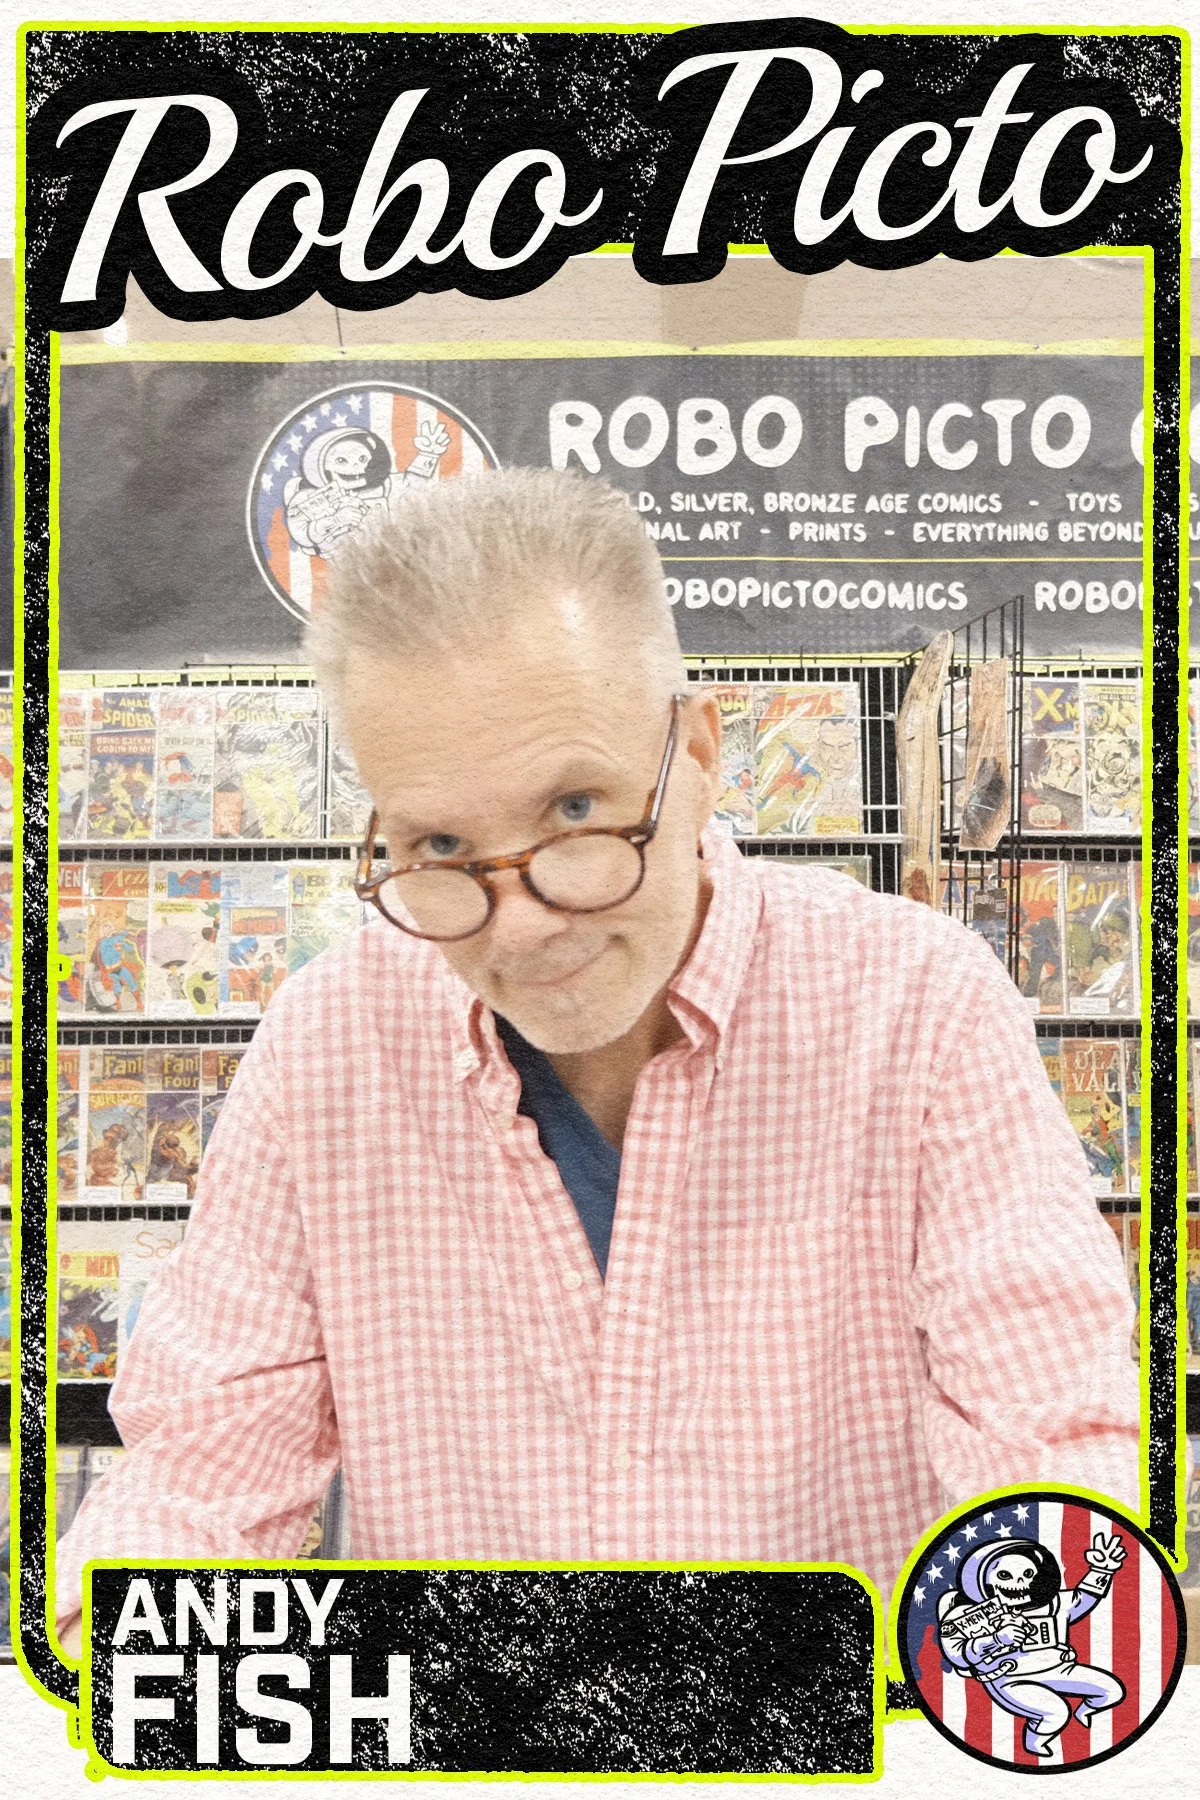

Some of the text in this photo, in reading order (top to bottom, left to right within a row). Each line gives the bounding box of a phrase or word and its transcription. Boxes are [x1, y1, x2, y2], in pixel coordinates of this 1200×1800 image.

[549, 395, 802, 475] ROBO
[844, 395, 1091, 472] PICTO
[631, 491, 661, 514] D,
[670, 491, 755, 515] SILVER,
[763, 492, 857, 514] BRONZE
[865, 494, 910, 514] AGE
[918, 493, 1002, 514] COMICS
[1065, 492, 1122, 513] TOYS
[698, 521, 742, 541] ART
[789, 522, 867, 542] PRINTS
[913, 521, 1049, 543] EVERYTHING
[1058, 521, 1144, 543] BEYOND
